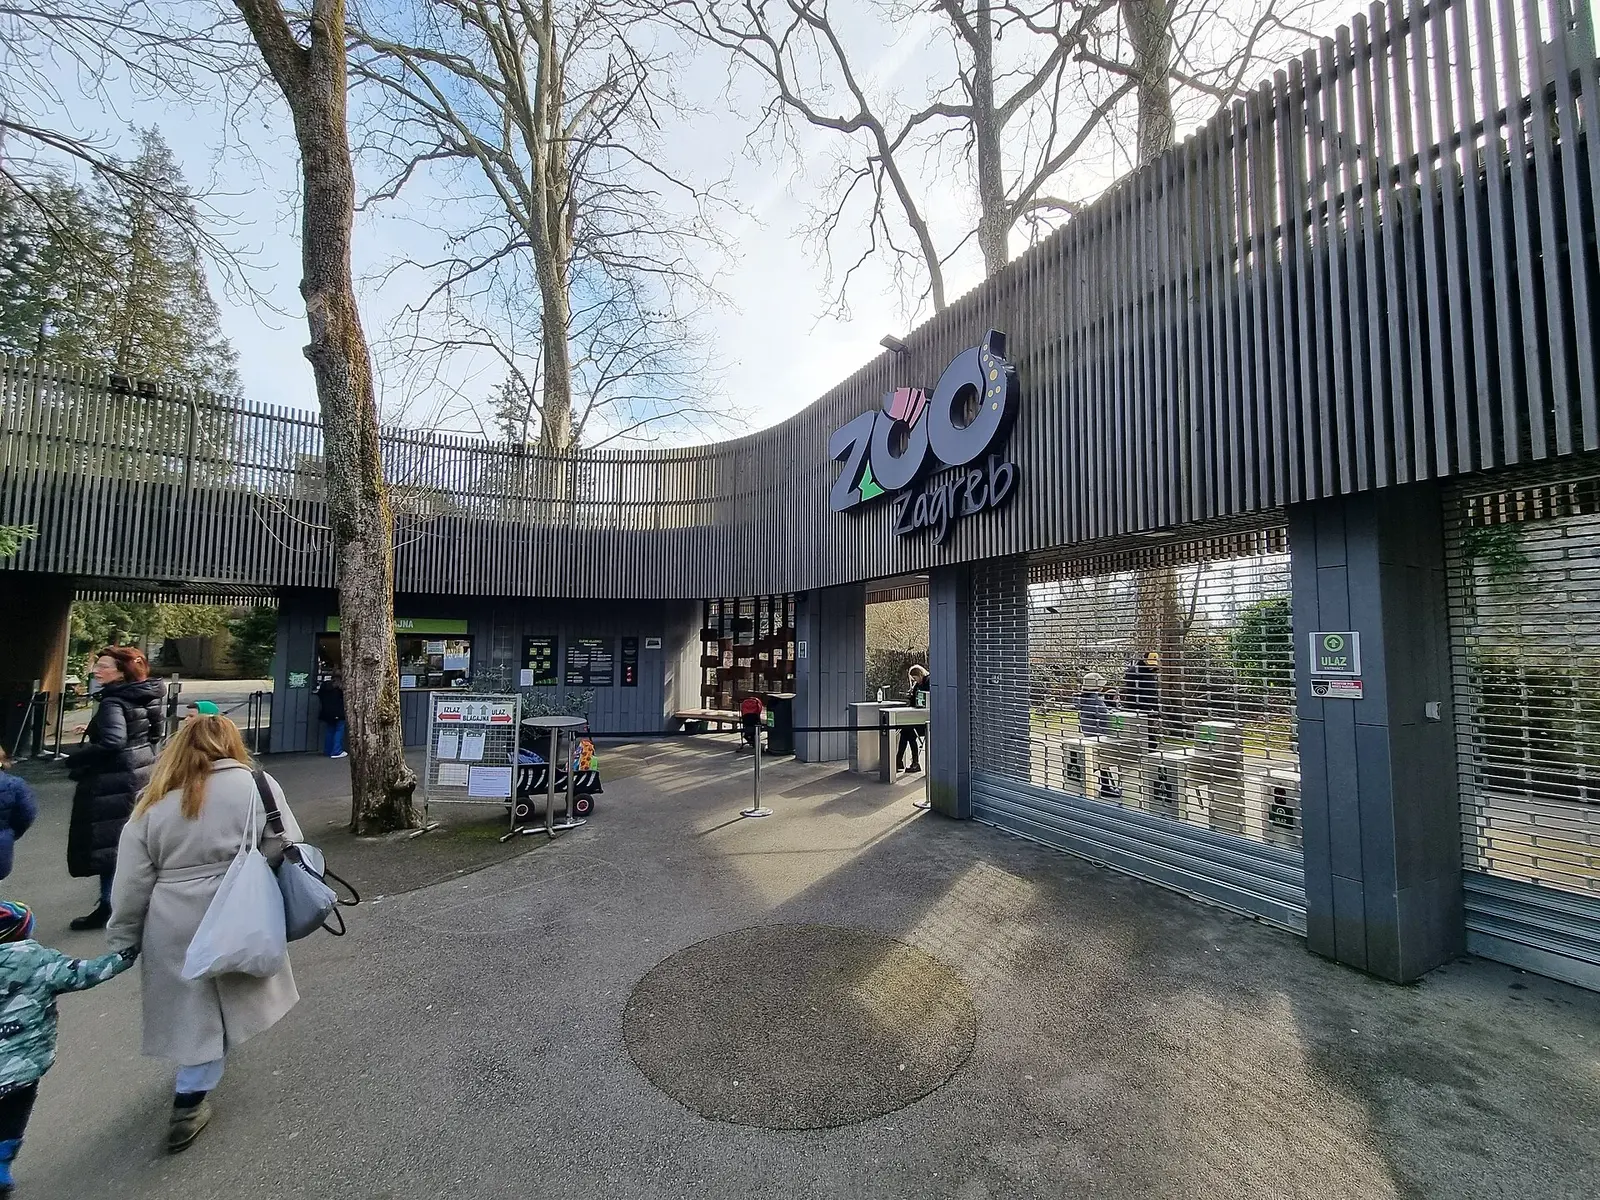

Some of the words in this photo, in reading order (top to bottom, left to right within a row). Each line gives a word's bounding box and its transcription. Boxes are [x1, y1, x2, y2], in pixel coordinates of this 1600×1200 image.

[829, 329, 1015, 512] ZOO
[893, 454, 1018, 545] Zagreb
[394, 619, 413, 628] AJNA
[1321, 656, 1347, 666] ULAZ
